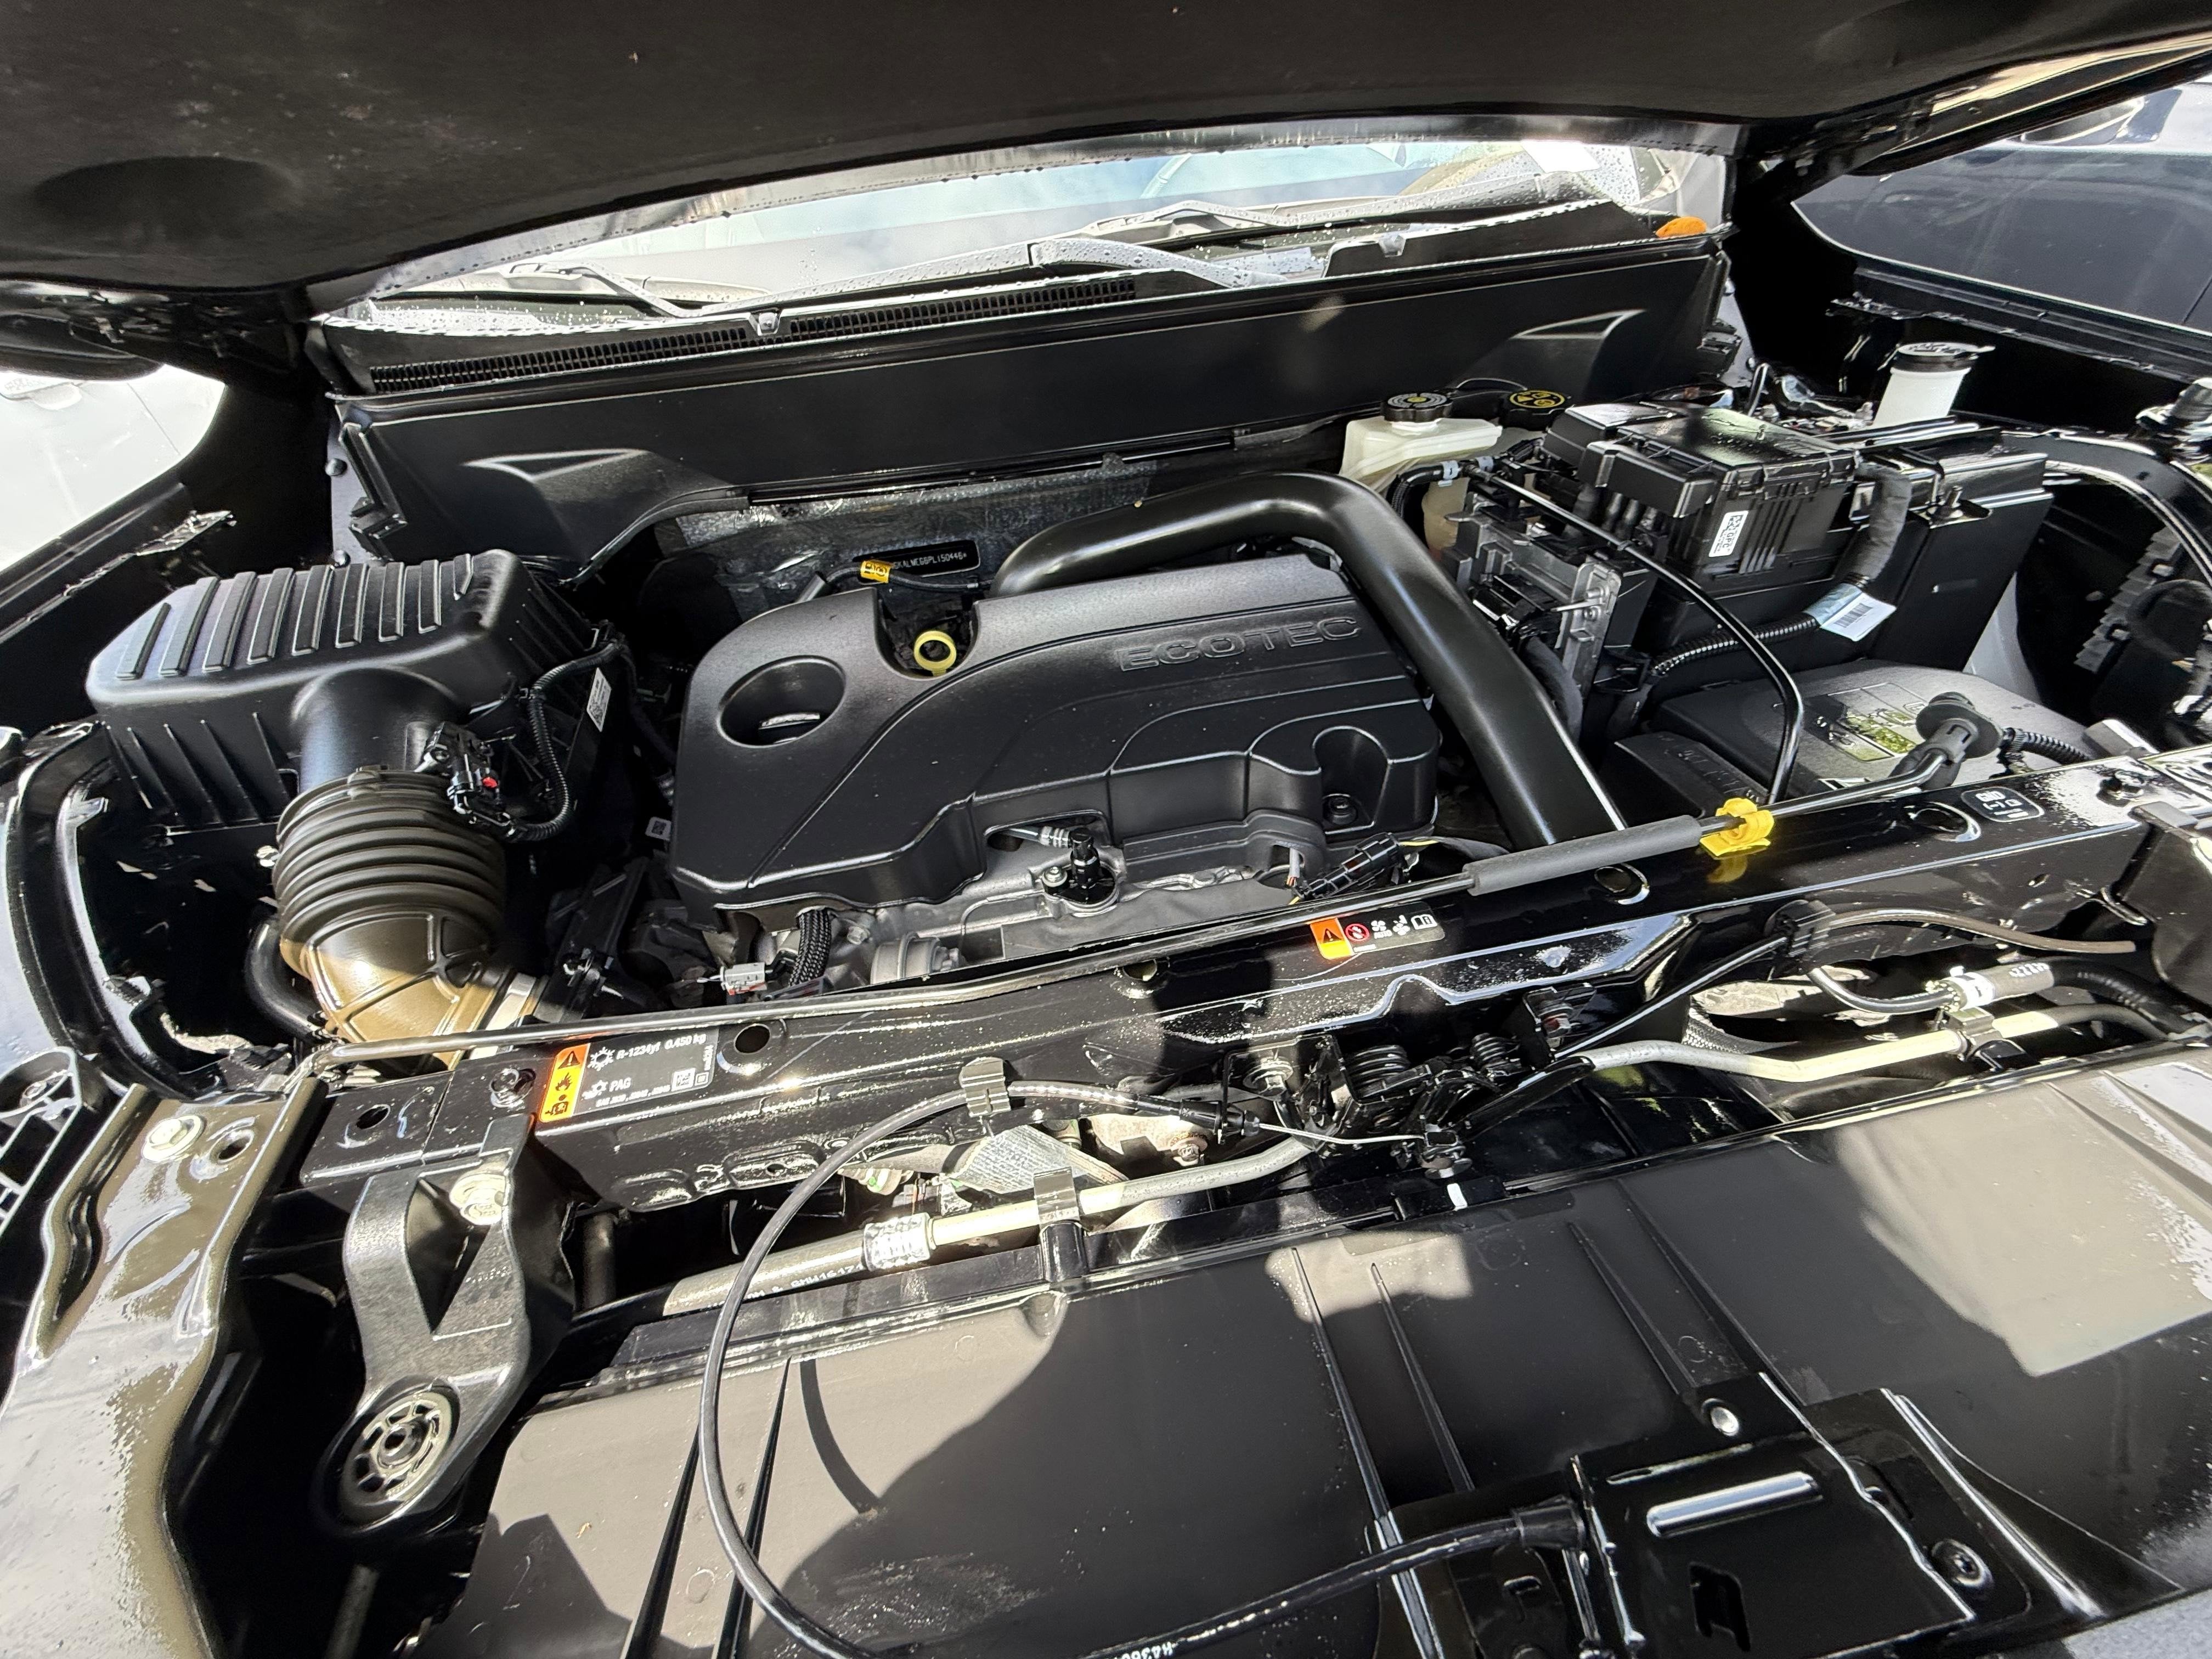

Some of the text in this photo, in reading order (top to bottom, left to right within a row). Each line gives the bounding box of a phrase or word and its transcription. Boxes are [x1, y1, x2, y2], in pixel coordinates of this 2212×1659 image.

[1117, 617, 1362, 672] ECOTEC
[1975, 790, 2006, 802] GND
[616, 1041, 661, 1060] R-1234yf
[664, 1034, 692, 1049] 0.450
[608, 1077, 631, 1092] PAG
